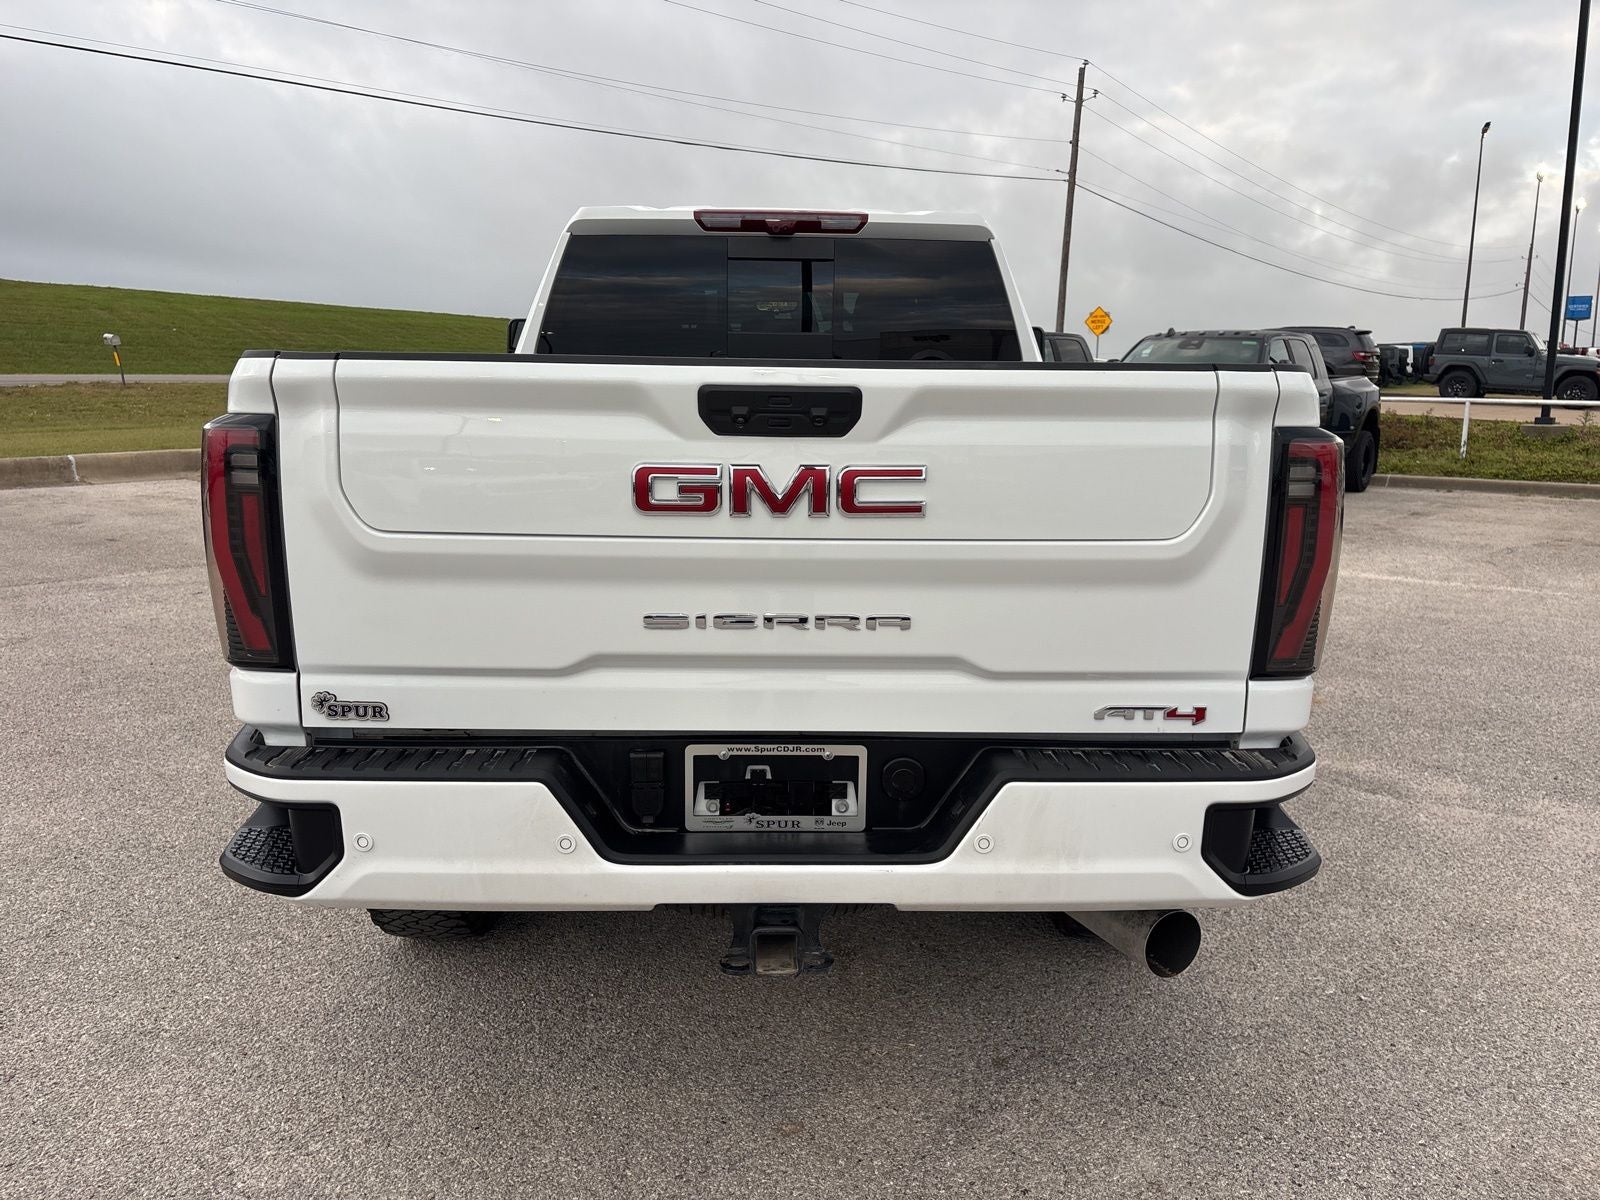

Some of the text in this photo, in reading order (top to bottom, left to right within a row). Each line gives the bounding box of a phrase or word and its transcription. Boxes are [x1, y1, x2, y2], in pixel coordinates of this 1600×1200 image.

[631, 462, 928, 518] GMC
[643, 612, 911, 631] SIERRA
[327, 704, 385, 718] SPUR
[1094, 705, 1207, 725] AT4
[727, 745, 826, 753] www.SpurCDJR.com
[755, 820, 802, 829] SPUR
[826, 819, 847, 828] Jeep
